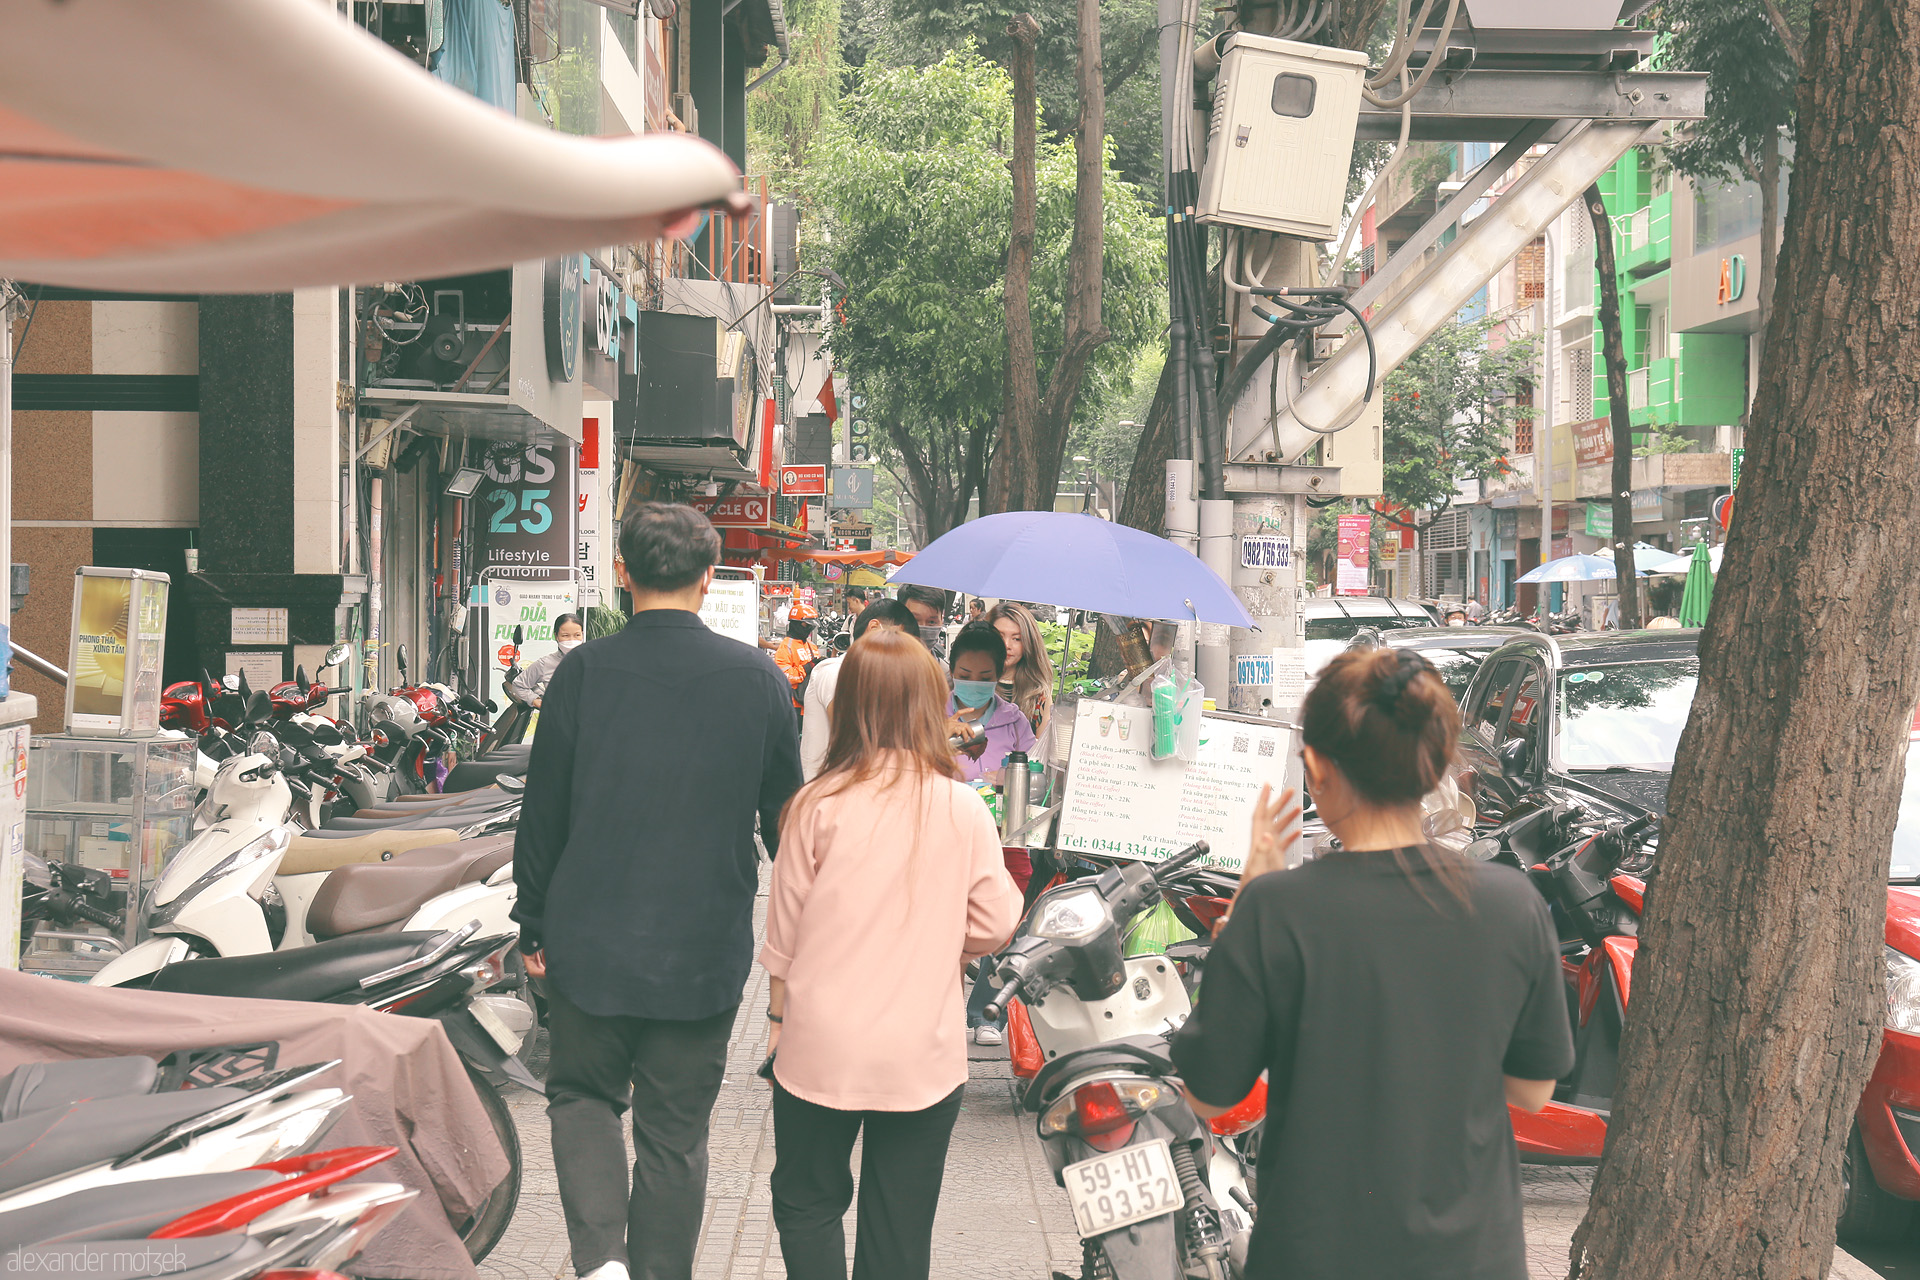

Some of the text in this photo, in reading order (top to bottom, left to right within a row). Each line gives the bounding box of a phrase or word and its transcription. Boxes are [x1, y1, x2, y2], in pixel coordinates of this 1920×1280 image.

[1717, 254, 1746, 305] AD
[596, 269, 620, 363] GS25
[484, 440, 556, 484] GS
[486, 489, 553, 534] 25
[488, 549, 550, 565] Lifestyle
[1243, 541, 1289, 567] 0982.756.333
[1064, 836, 1087, 848] Tel:
[1092, 838, 1121, 852] 0344
[1125, 843, 1147, 856] 334
[1151, 846, 1174, 860] 456
[1142, 834, 1159, 843] P&T
[1160, 837, 1178, 845] thank
[1080, 1149, 1152, 1194] 59-H1
[1080, 1177, 1174, 1234] 193.52
